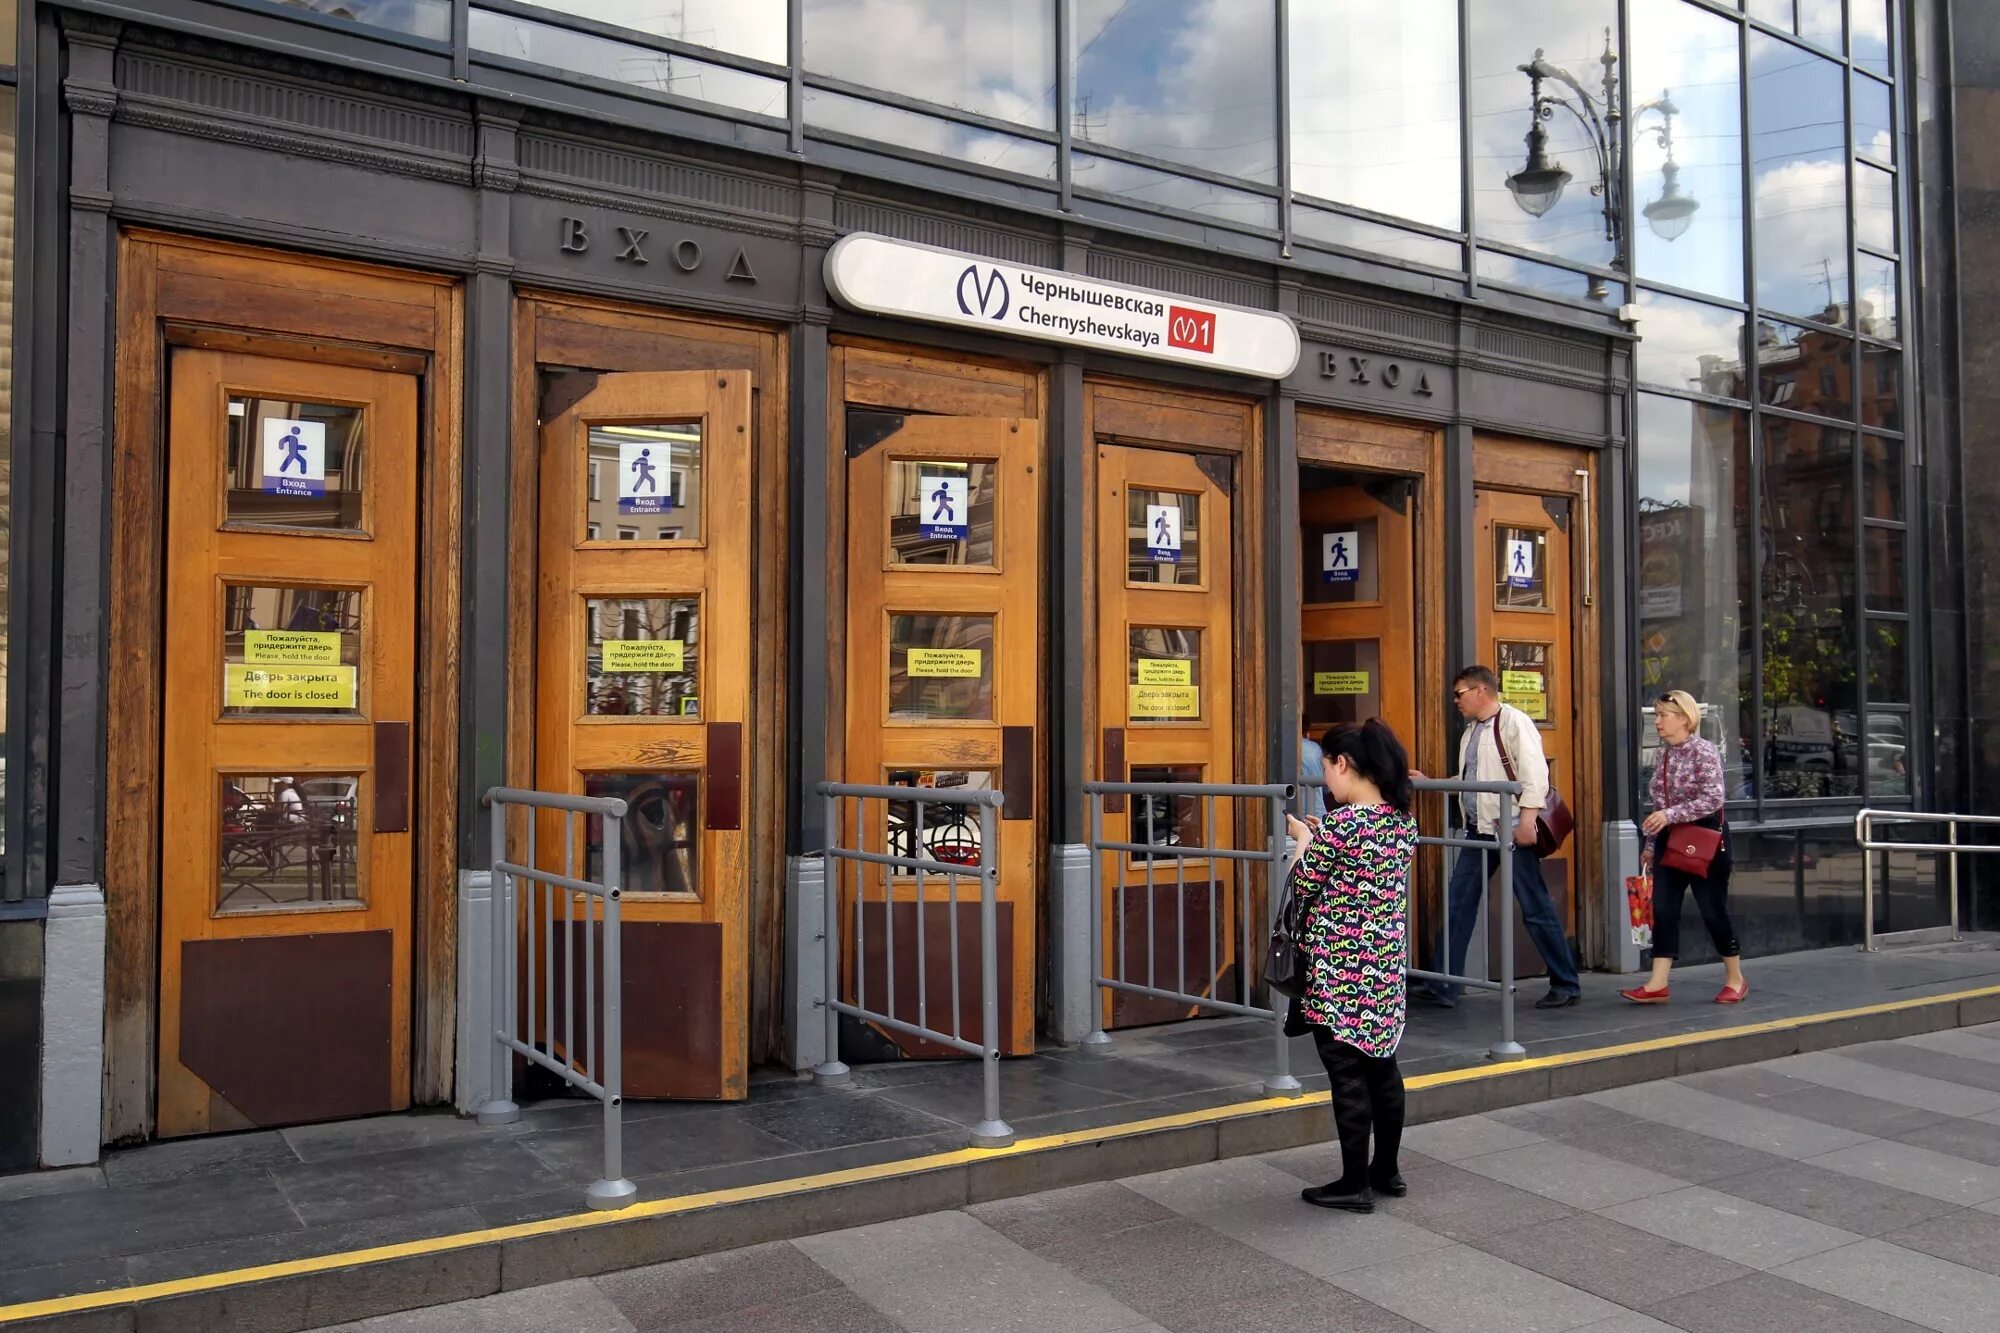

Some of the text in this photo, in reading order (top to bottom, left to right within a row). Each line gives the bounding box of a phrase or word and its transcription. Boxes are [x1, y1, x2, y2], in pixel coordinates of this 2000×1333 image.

[560, 216, 758, 285] ВХОД
[1020, 273, 1164, 318] Чернышевская
[1018, 305, 1160, 348] Chernyshevskaya
[1318, 351, 1433, 398] ВХОД
[282, 479, 307, 489] Вход
[276, 487, 312, 496] Entrance
[635, 498, 655, 506] Вход
[267, 634, 320, 643] Пожалуйста,
[254, 642, 307, 650] придержите
[244, 671, 338, 684] Дверь закрыта
[243, 689, 339, 699] The door is closed
[1138, 691, 1159, 699] Дверь
